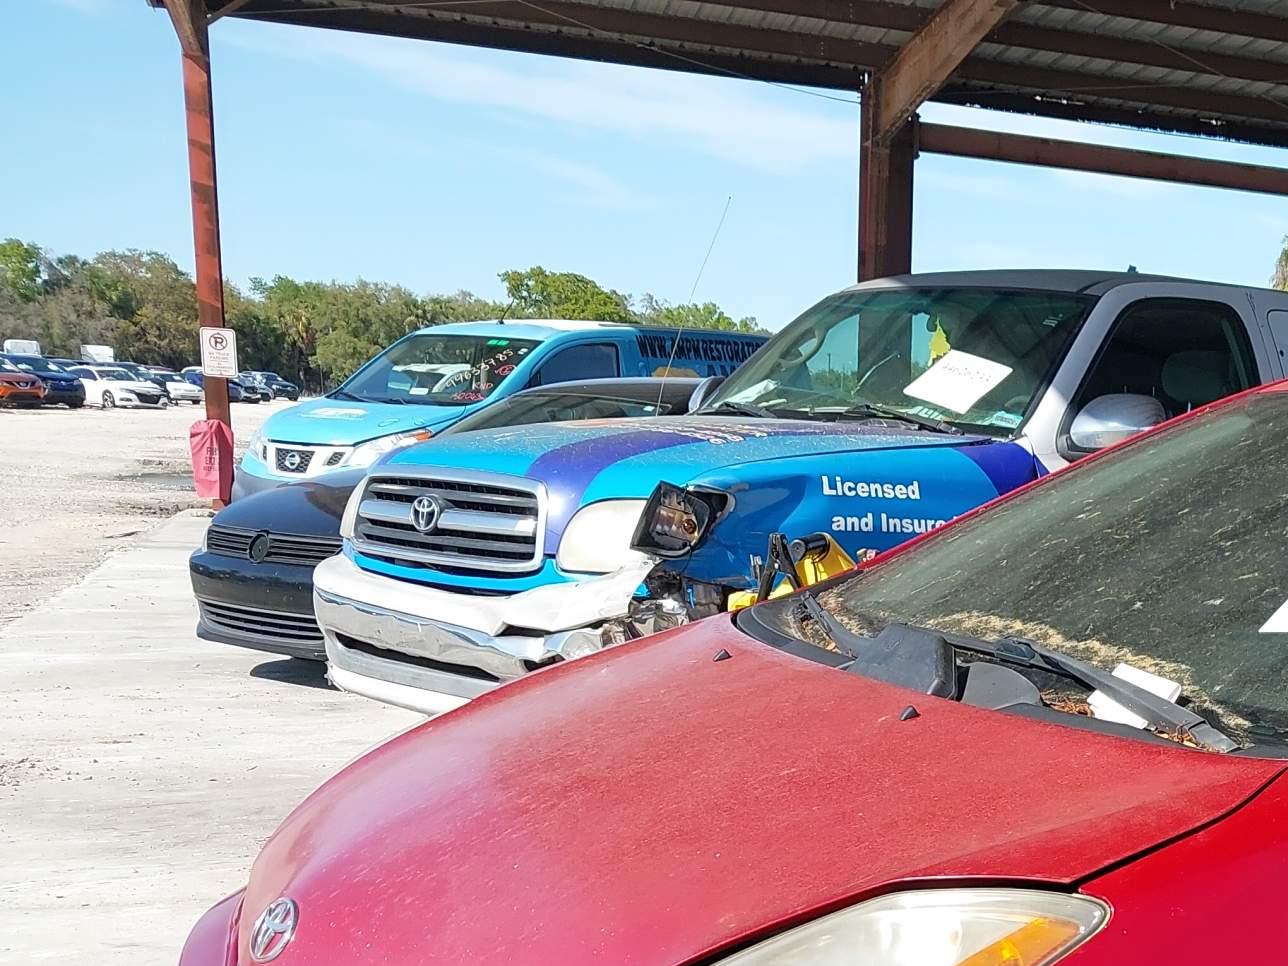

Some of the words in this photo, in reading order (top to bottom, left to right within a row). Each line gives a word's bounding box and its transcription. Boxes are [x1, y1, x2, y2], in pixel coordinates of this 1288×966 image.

[821, 475, 921, 500] Licensed
[831, 512, 874, 532] and
[881, 512, 957, 534] Insure
